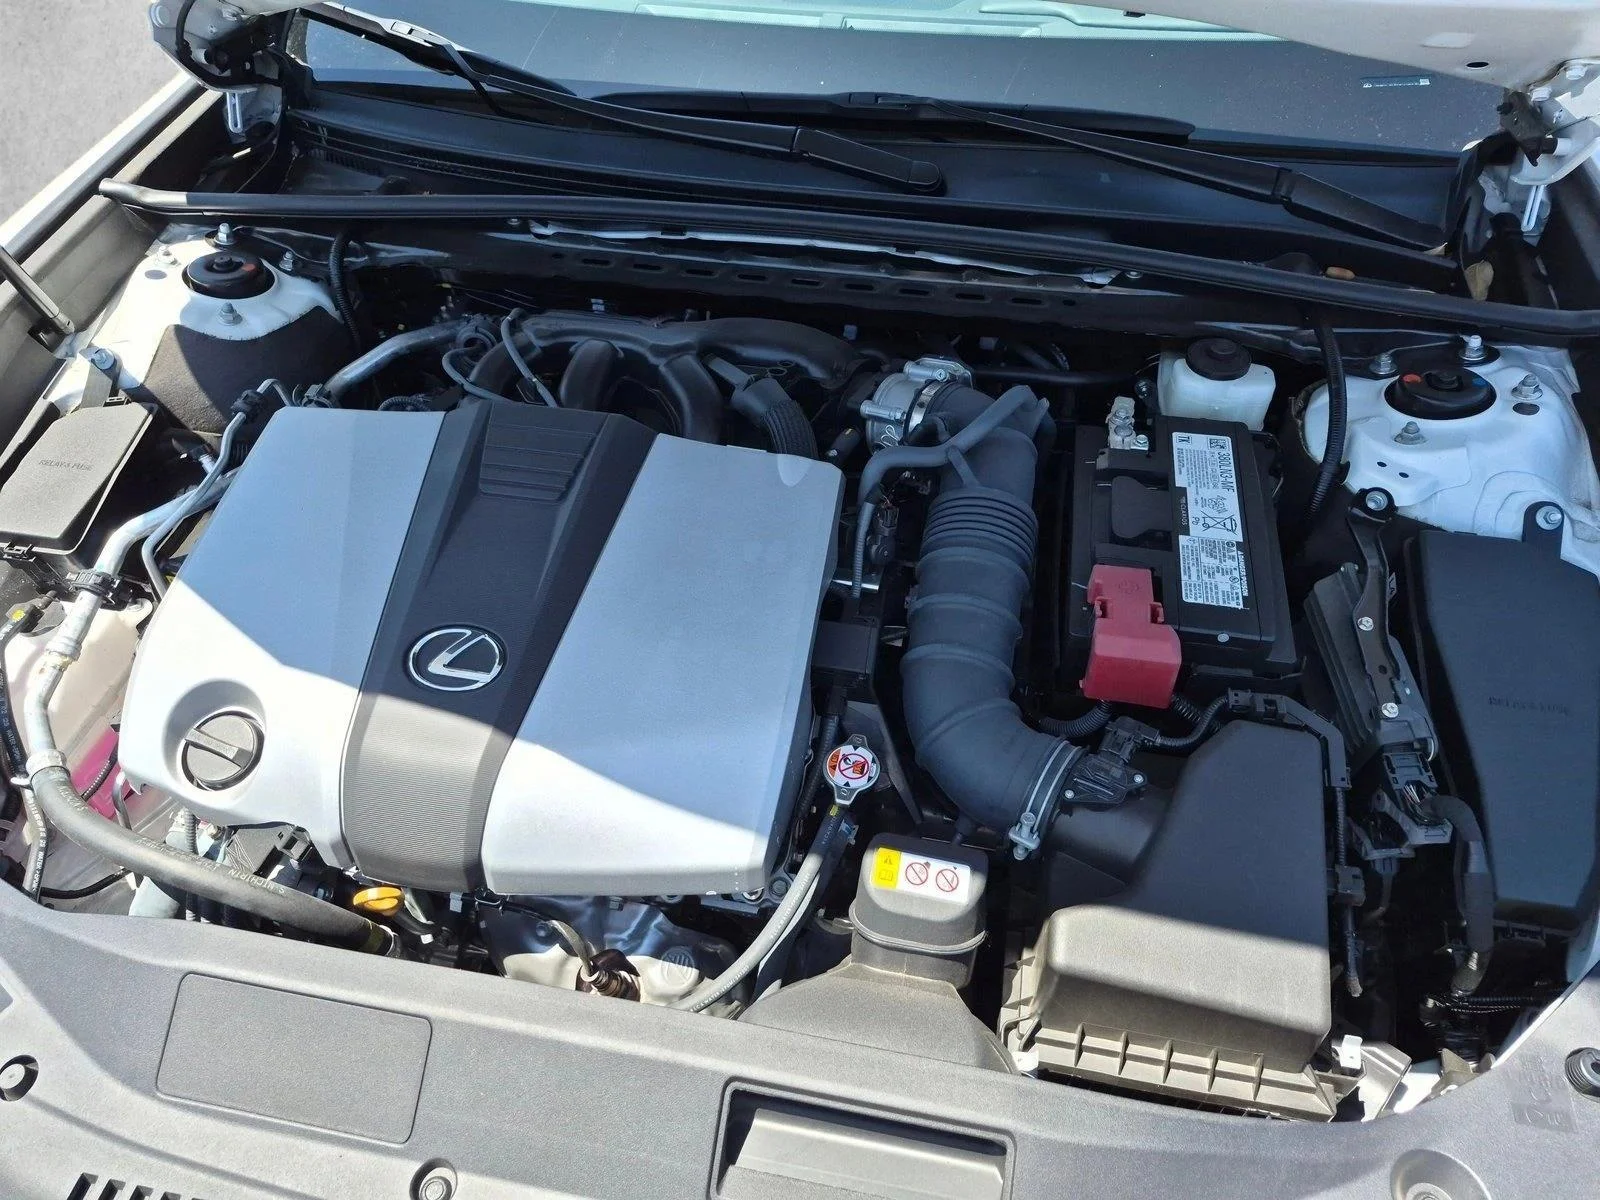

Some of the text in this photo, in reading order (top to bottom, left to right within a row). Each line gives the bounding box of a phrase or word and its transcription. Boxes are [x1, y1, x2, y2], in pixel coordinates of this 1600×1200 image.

[1178, 435, 1191, 444] TK
[1217, 451, 1235, 493] 380LN3-MF
[1180, 503, 1188, 526] CLARIOS
[1192, 516, 1200, 526] Pb
